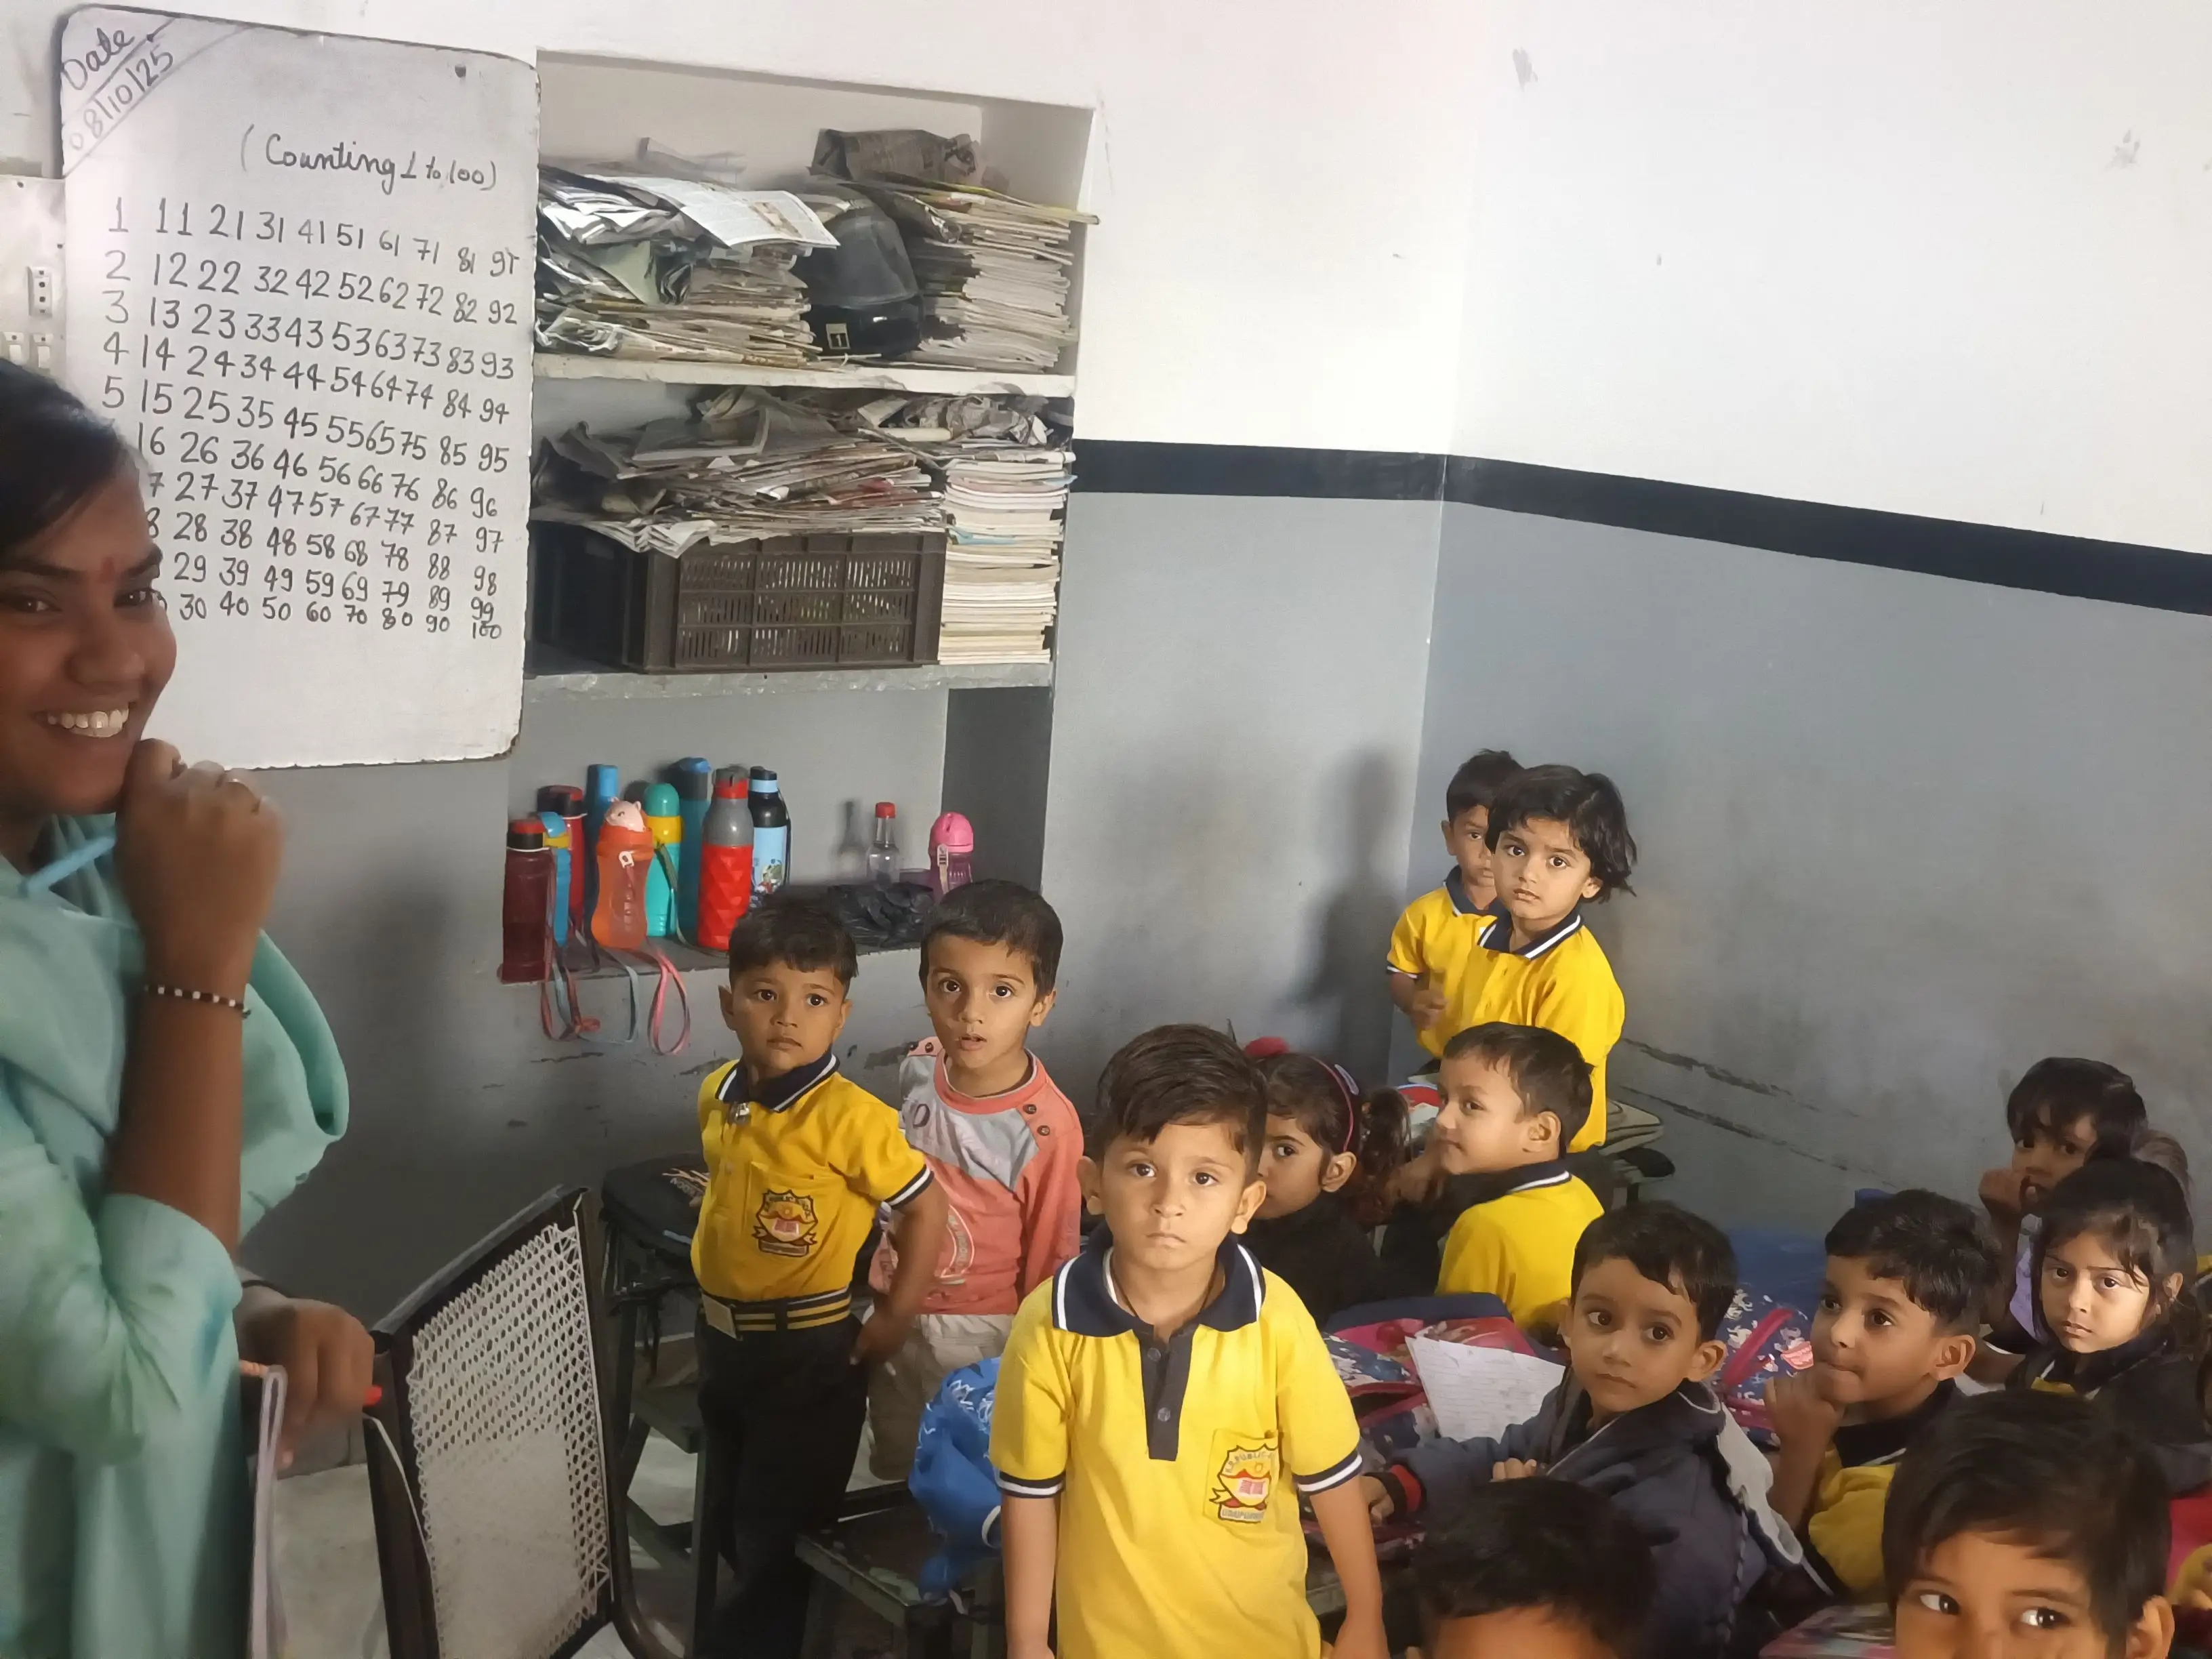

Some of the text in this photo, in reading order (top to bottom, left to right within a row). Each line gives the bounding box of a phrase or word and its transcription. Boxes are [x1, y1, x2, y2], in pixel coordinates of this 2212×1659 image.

[60, 28, 136, 91] Date
[69, 43, 173, 150] 08/10/25
[426, 156, 441, 180] to
[108, 197, 129, 232] 1
[156, 197, 193, 236] 11
[209, 204, 243, 241] 21
[256, 211, 284, 243] 31
[298, 219, 325, 249] 41
[337, 223, 363, 249] 51
[379, 230, 399, 257] 61
[412, 238, 439, 264] 71
[457, 247, 476, 274] 81
[105, 250, 517, 325] 2 12 22 32 42 52 62 72 82 92
[102, 290, 514, 380] 3 13 23 33 43 53 63 73 83 93
[103, 331, 510, 425] 4 14 24 34 44 54 64 74 84 94
[102, 375, 510, 473] 5 15 25 35 45 55 65 75 85 95
[138, 422, 497, 518] 16 26 36 46 56 66 76 86 96
[173, 512, 207, 542] 28
[221, 518, 252, 549] 38
[266, 527, 297, 557] 48
[306, 534, 335, 559] 58
[344, 539, 368, 567] 68
[381, 539, 409, 571] 78
[428, 553, 450, 581] 88
[474, 565, 497, 596] 98
[175, 472, 219, 501] 27
[222, 478, 258, 510] 37
[268, 485, 304, 518] 47
[309, 491, 345, 518] 57
[350, 501, 380, 528] 67
[384, 508, 415, 535] 77
[428, 518, 457, 546] 87
[476, 527, 504, 554] 97
[174, 552, 494, 623] 29 39 49 59 69 79 89 99
[180, 593, 207, 621] 30
[220, 591, 249, 617] 40
[262, 596, 291, 621] 50
[306, 600, 331, 624] 60
[344, 604, 367, 624] 70
[382, 607, 413, 630] 80
[426, 615, 450, 633] 90
[472, 621, 502, 639] 100
